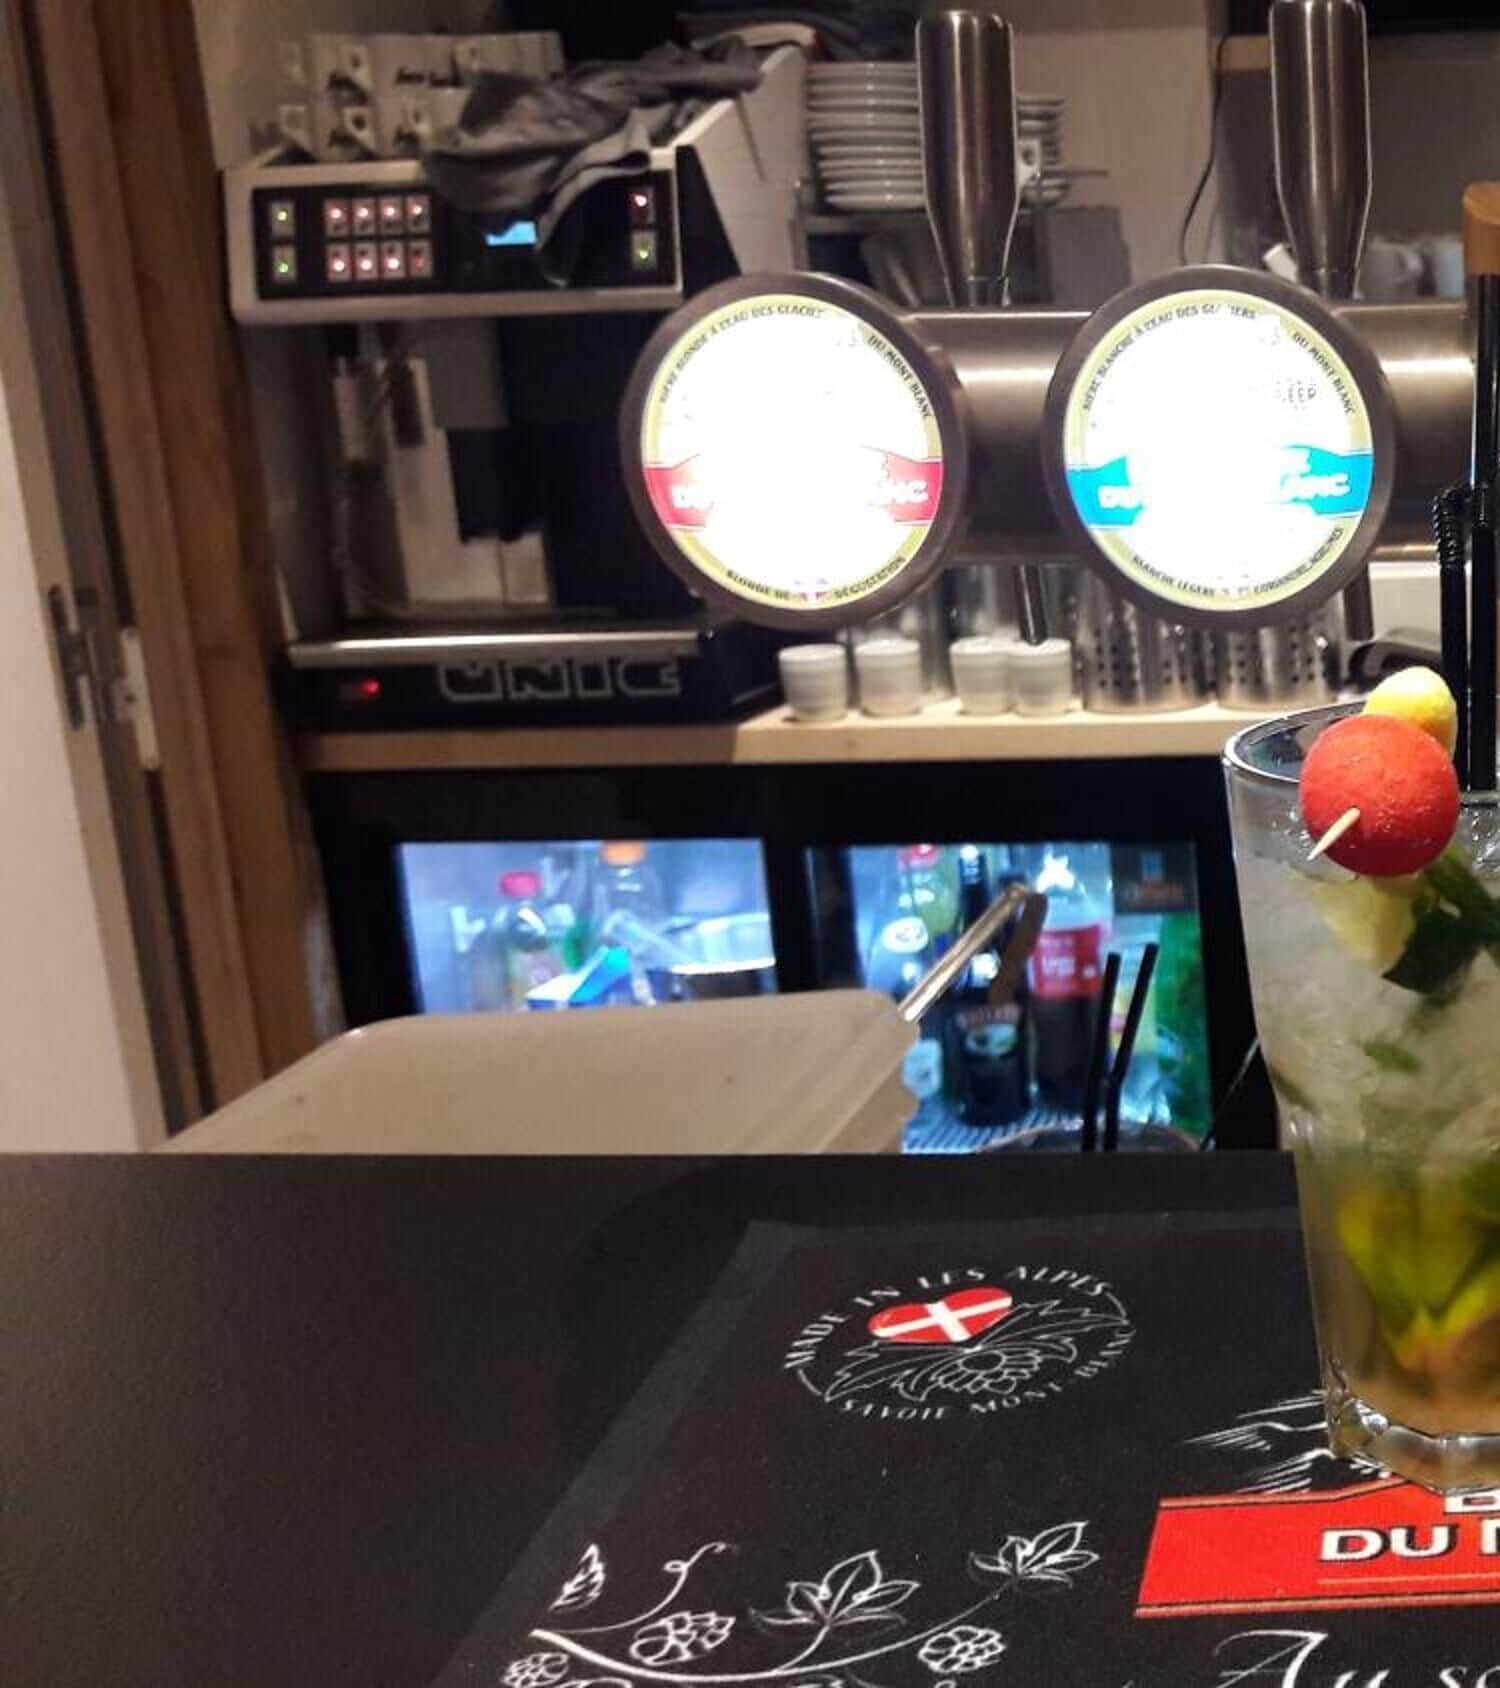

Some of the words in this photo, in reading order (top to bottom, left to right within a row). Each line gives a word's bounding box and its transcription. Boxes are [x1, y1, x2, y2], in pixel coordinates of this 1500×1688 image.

[783, 1313, 849, 1370] MADE
[1007, 1265, 1109, 1297] ALPES
[1319, 1525, 1457, 1563] DU
[1213, 1628, 1391, 1687] Au
